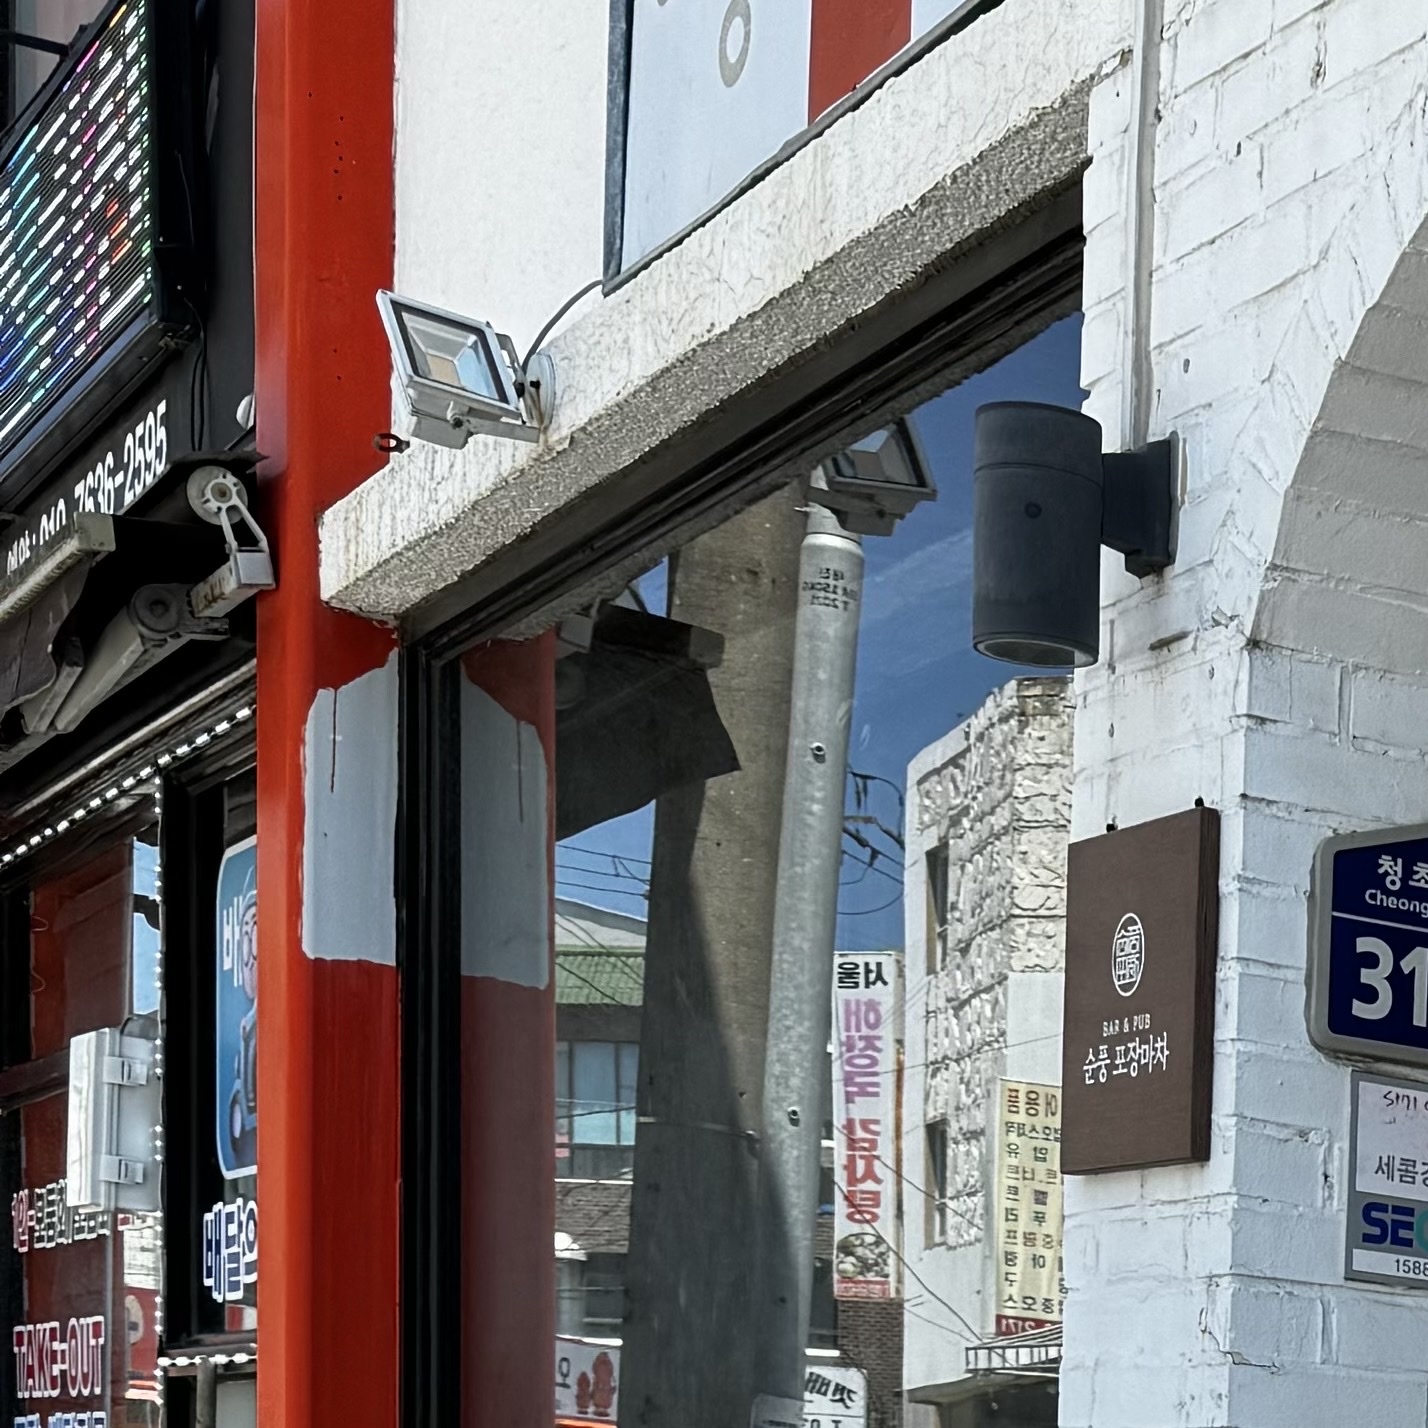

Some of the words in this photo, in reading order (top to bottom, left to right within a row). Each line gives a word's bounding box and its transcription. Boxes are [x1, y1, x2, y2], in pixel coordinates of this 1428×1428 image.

[1102, 1018, 1121, 1038] BAR
[1123, 1016, 1130, 1034] &
[1132, 1012, 1151, 1032] PUB
[1082, 1044, 1111, 1085] 순풍
[1112, 1030, 1170, 1079] 포장마차
[13, 1315, 104, 1399] TAKE-OUT
